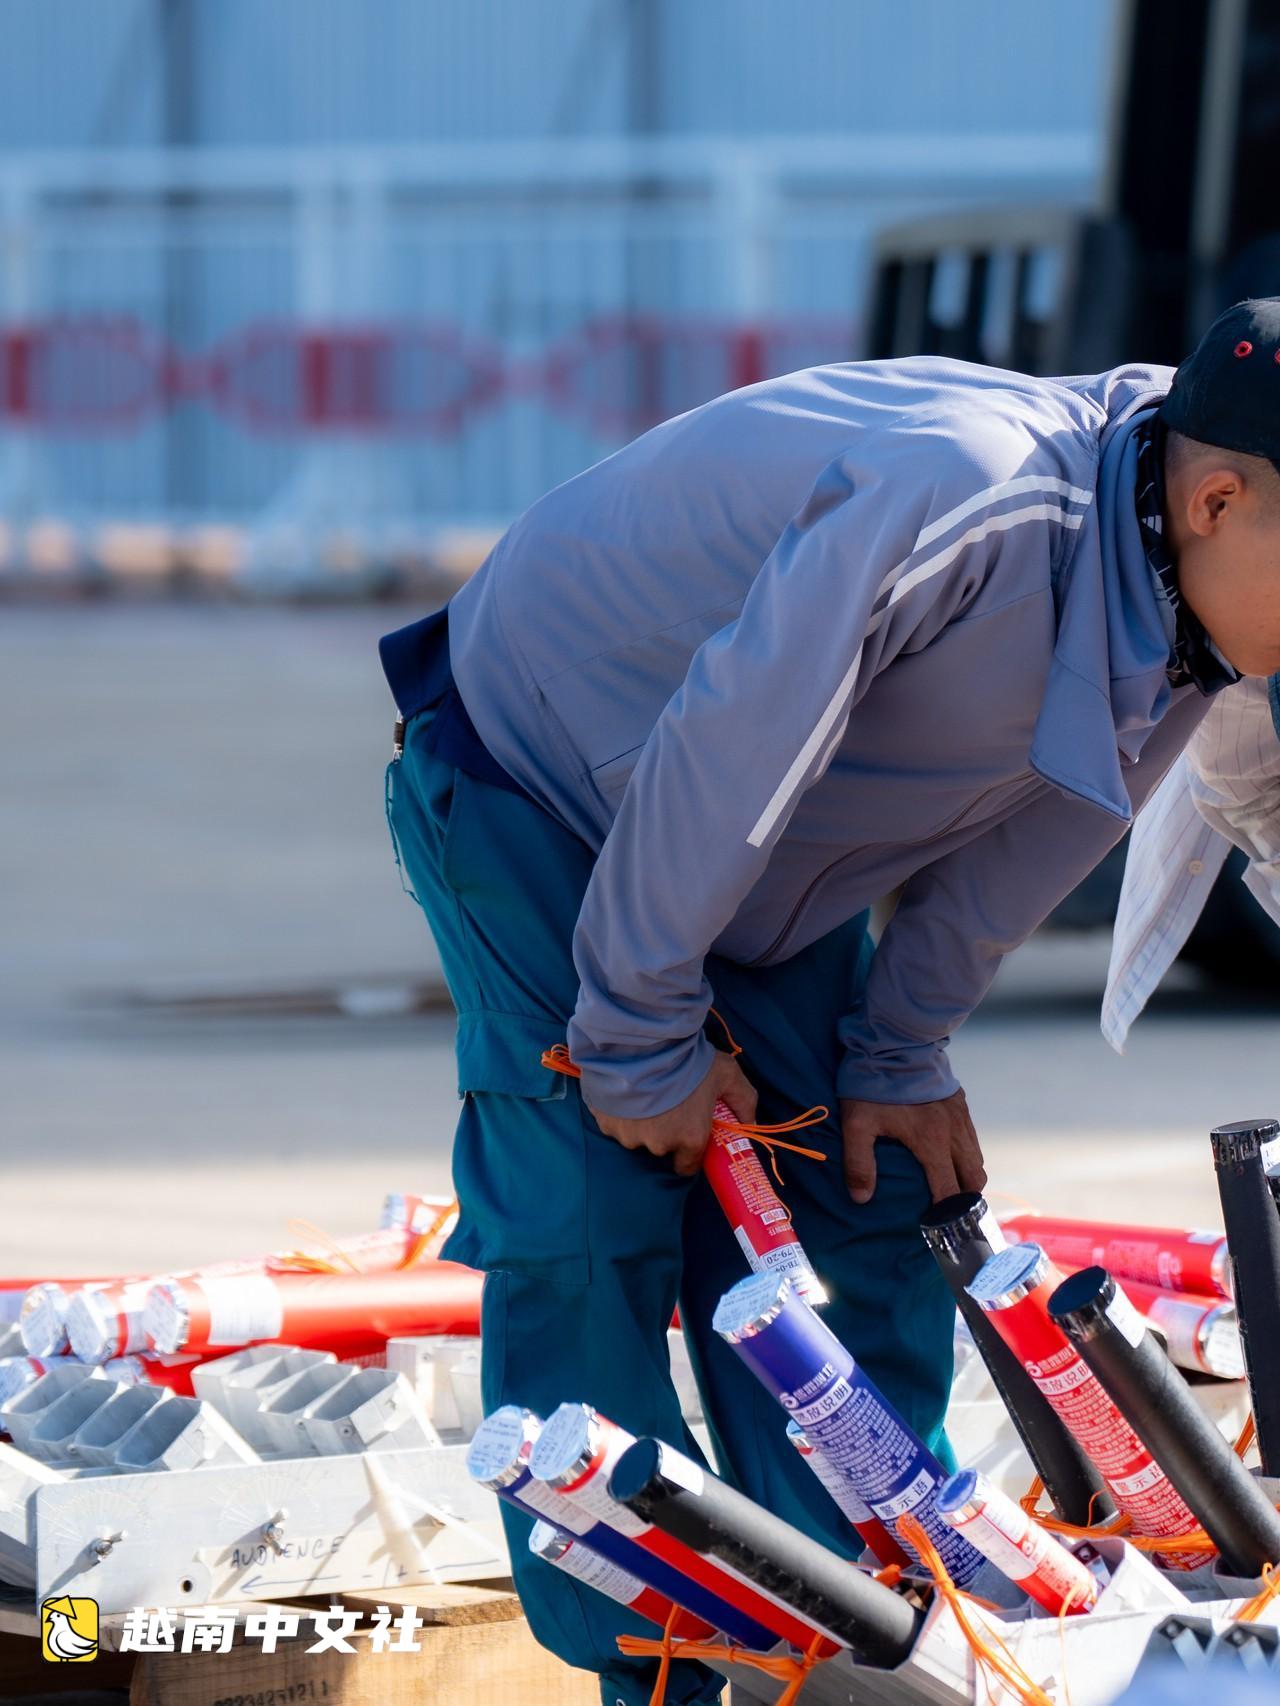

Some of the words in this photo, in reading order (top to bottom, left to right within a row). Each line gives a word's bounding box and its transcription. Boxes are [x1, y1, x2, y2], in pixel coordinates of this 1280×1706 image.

[766, 1249, 793, 1265] 79-20
[880, 1480, 928, 1517] 警示语
[230, 1536, 346, 1568] AUDIENCE
